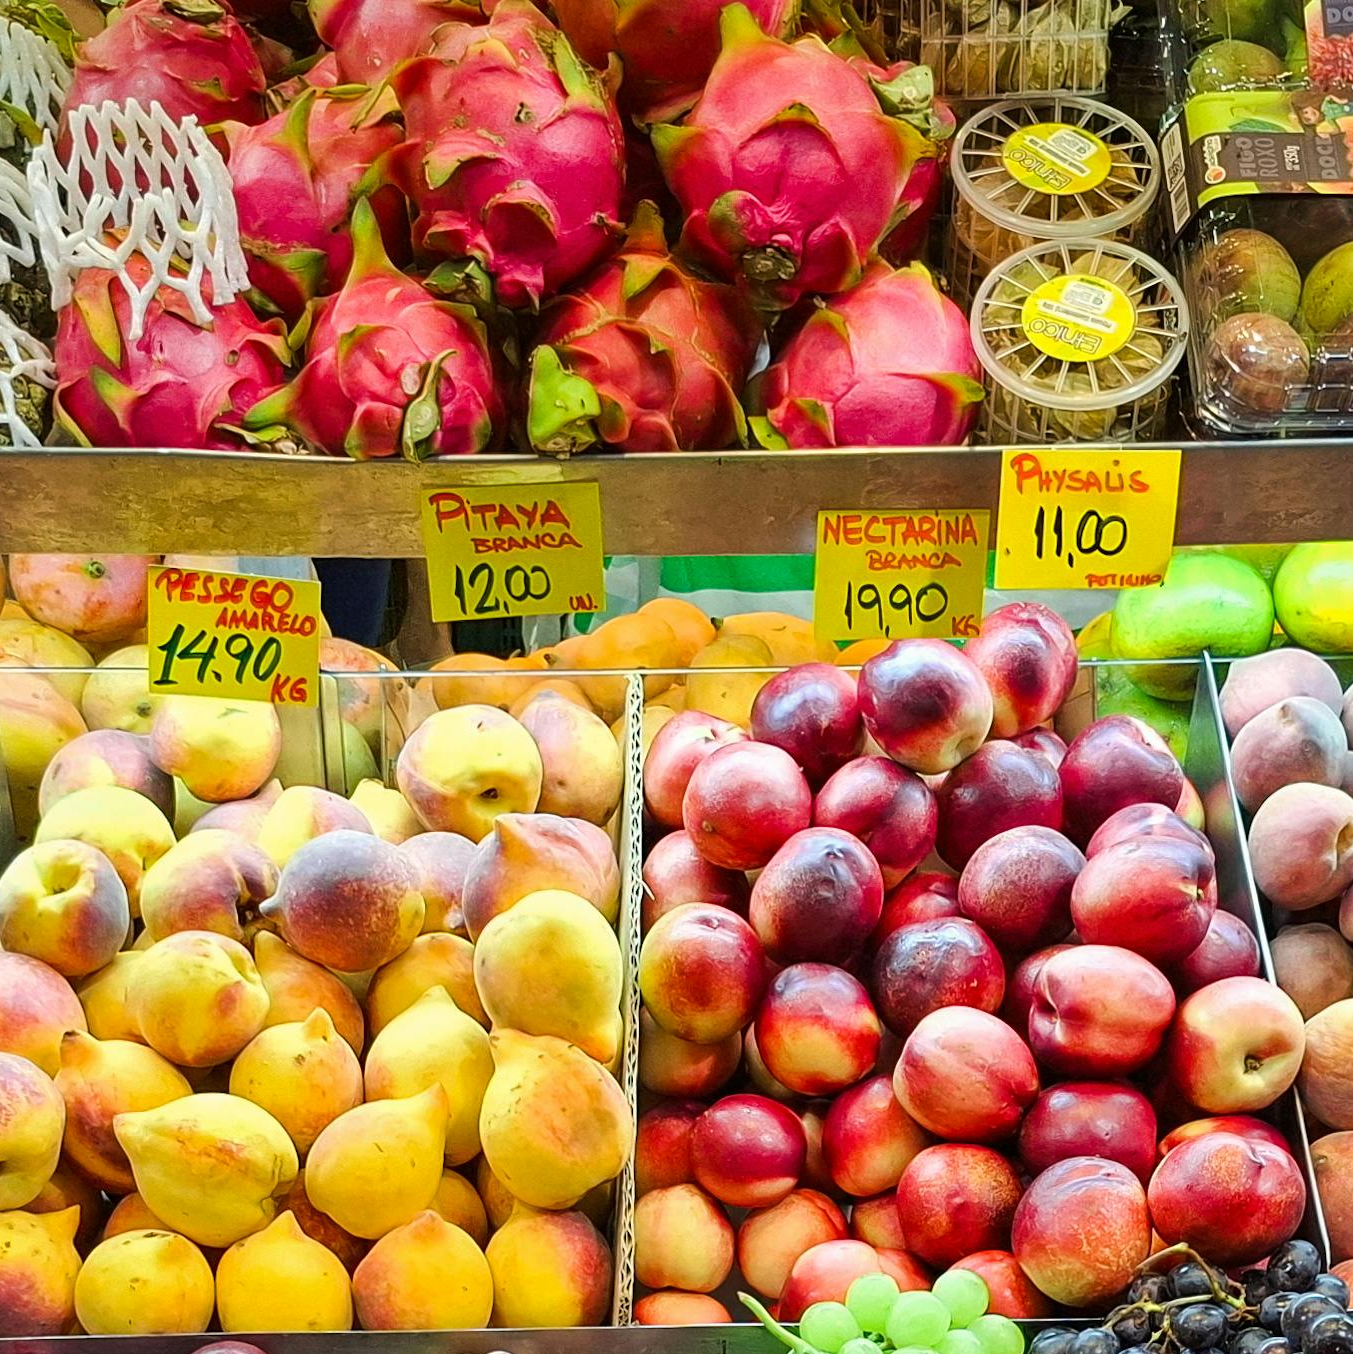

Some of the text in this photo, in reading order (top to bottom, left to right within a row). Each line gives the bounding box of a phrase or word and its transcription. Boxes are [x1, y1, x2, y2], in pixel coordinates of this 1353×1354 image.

[1235, 136, 1259, 178] FIGO
[1254, 137, 1280, 178] ROXO
[470, 531, 583, 554] BRANCA
[1034, 505, 1128, 568] 11,00
[865, 549, 962, 571] BRANCA
[155, 567, 295, 613] PESSEGO
[454, 562, 552, 616] 12,00
[844, 580, 949, 638] 19,90
[215, 606, 317, 637] AMARELO
[951, 614, 980, 636] KG
[270, 673, 308, 703] KG
